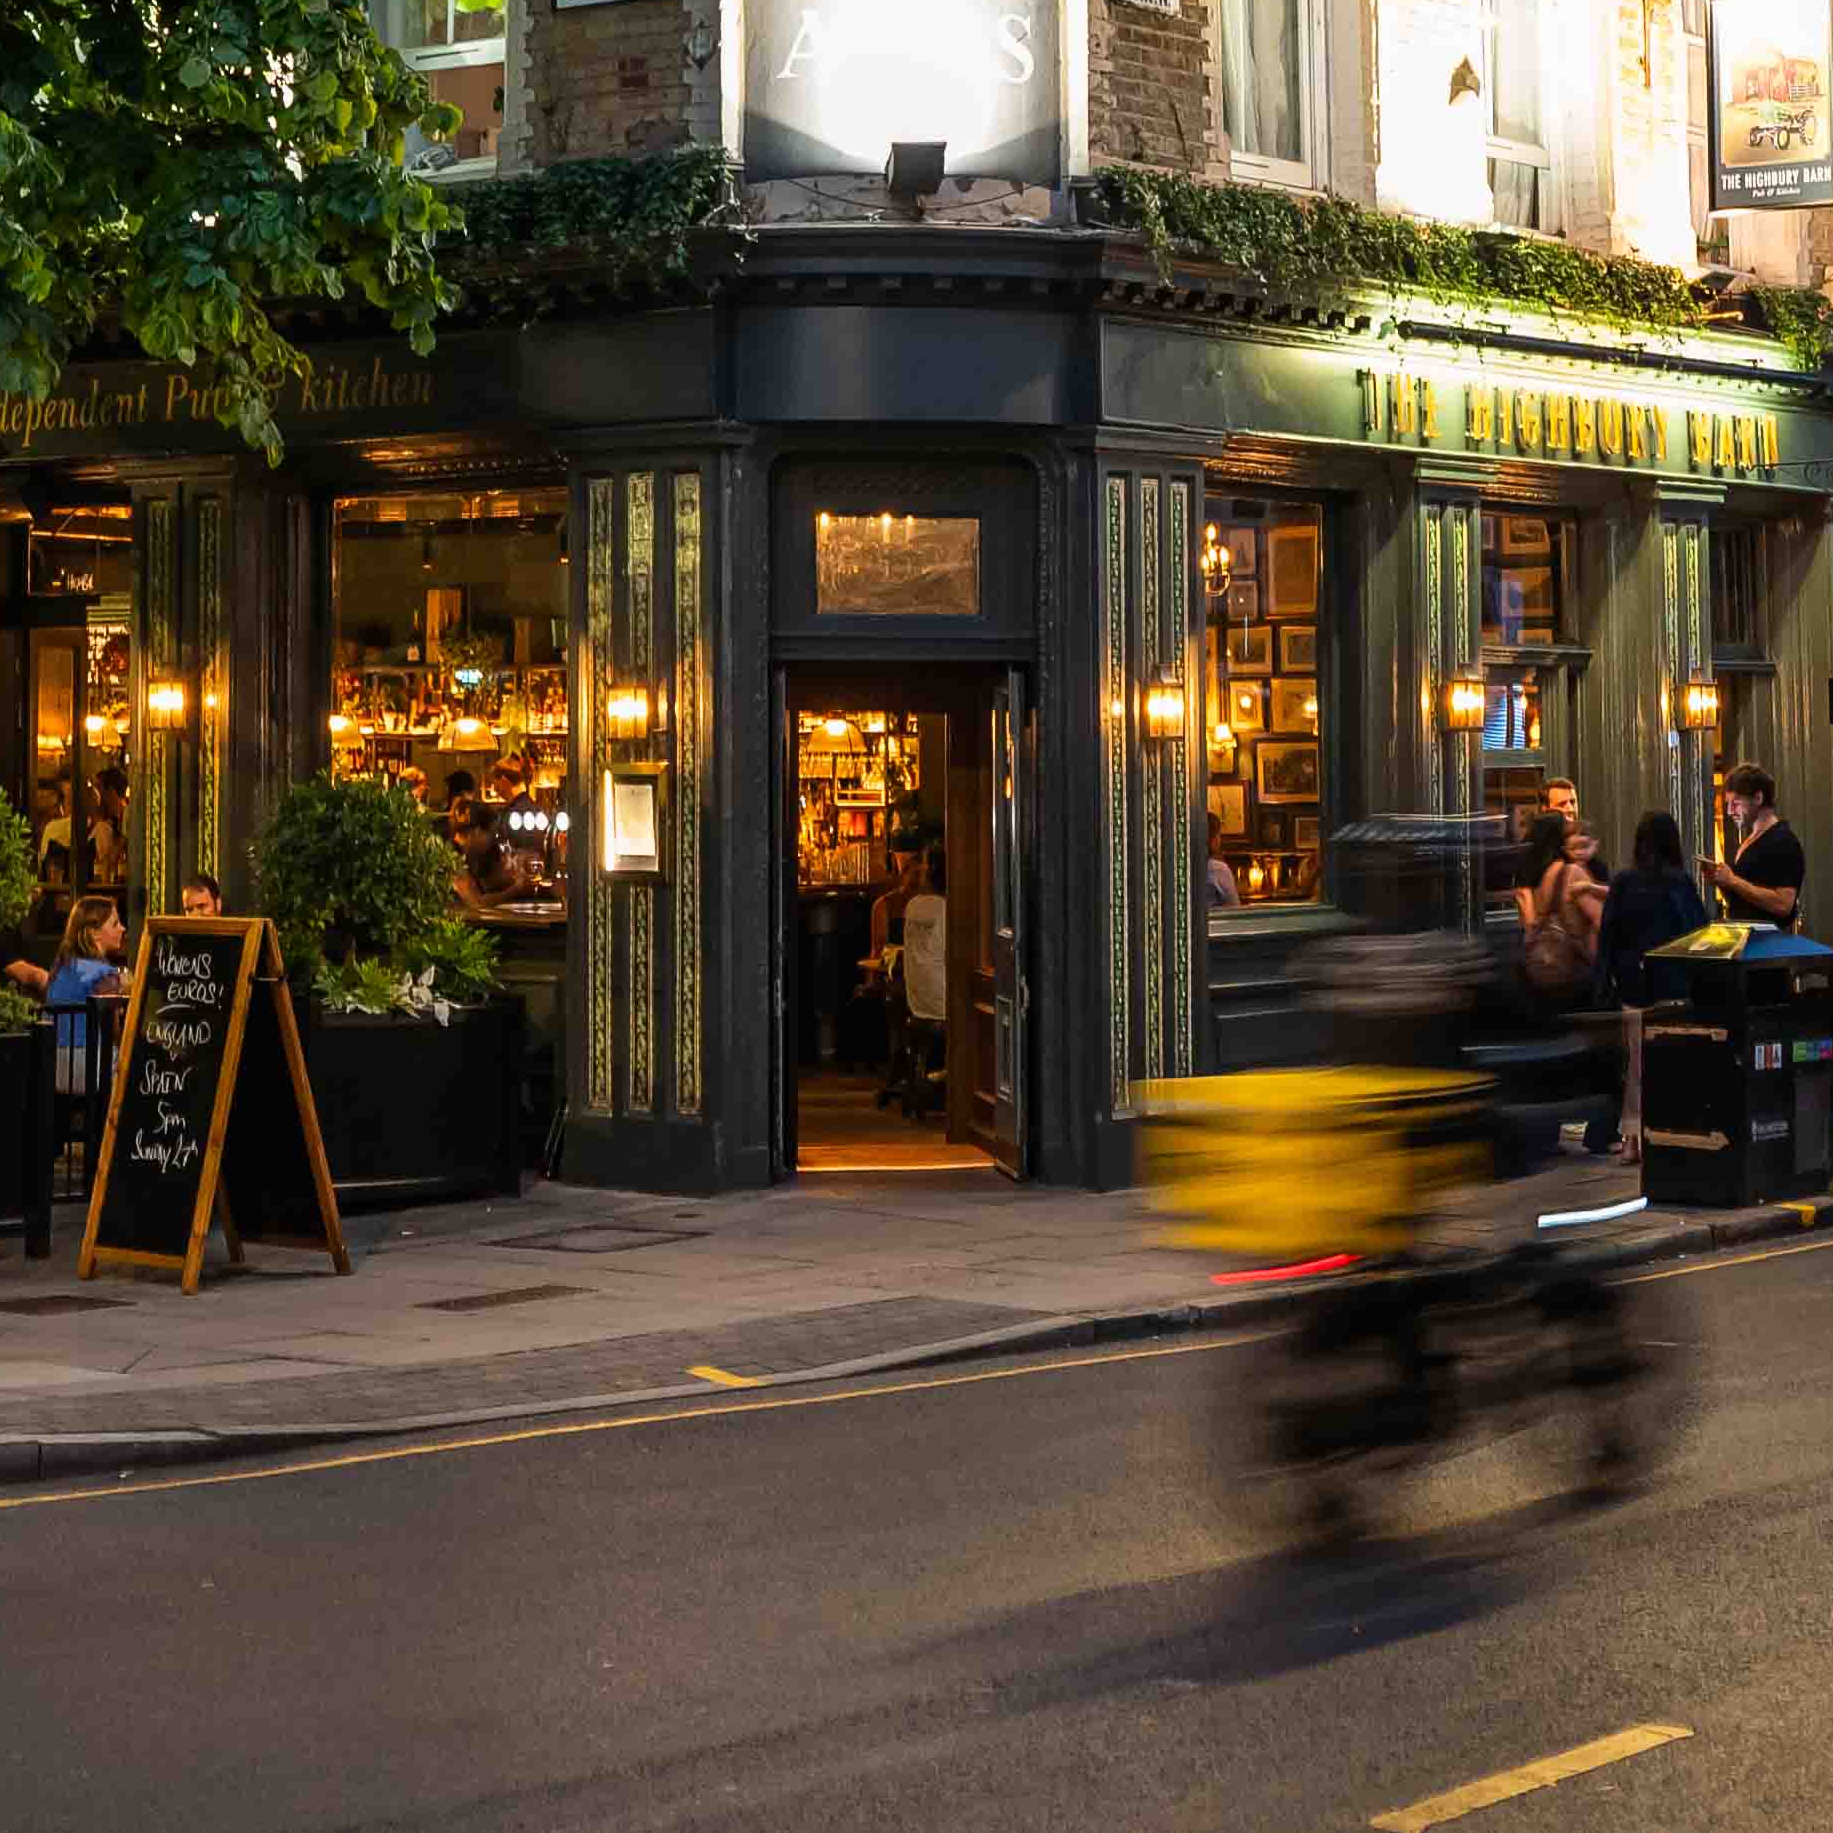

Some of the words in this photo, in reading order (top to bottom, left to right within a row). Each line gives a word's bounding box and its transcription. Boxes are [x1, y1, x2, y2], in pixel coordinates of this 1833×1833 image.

[775, 8, 1035, 85] AS
[1721, 173, 1742, 191] THE
[1745, 169, 1799, 188] HIGHBURY
[1803, 165, 1832, 183] BARN
[1362, 368, 1442, 440] THE
[1465, 386, 1666, 461] HIGHBURY
[1687, 409, 1778, 470] BARN
[166, 979, 225, 1012] EUROS!
